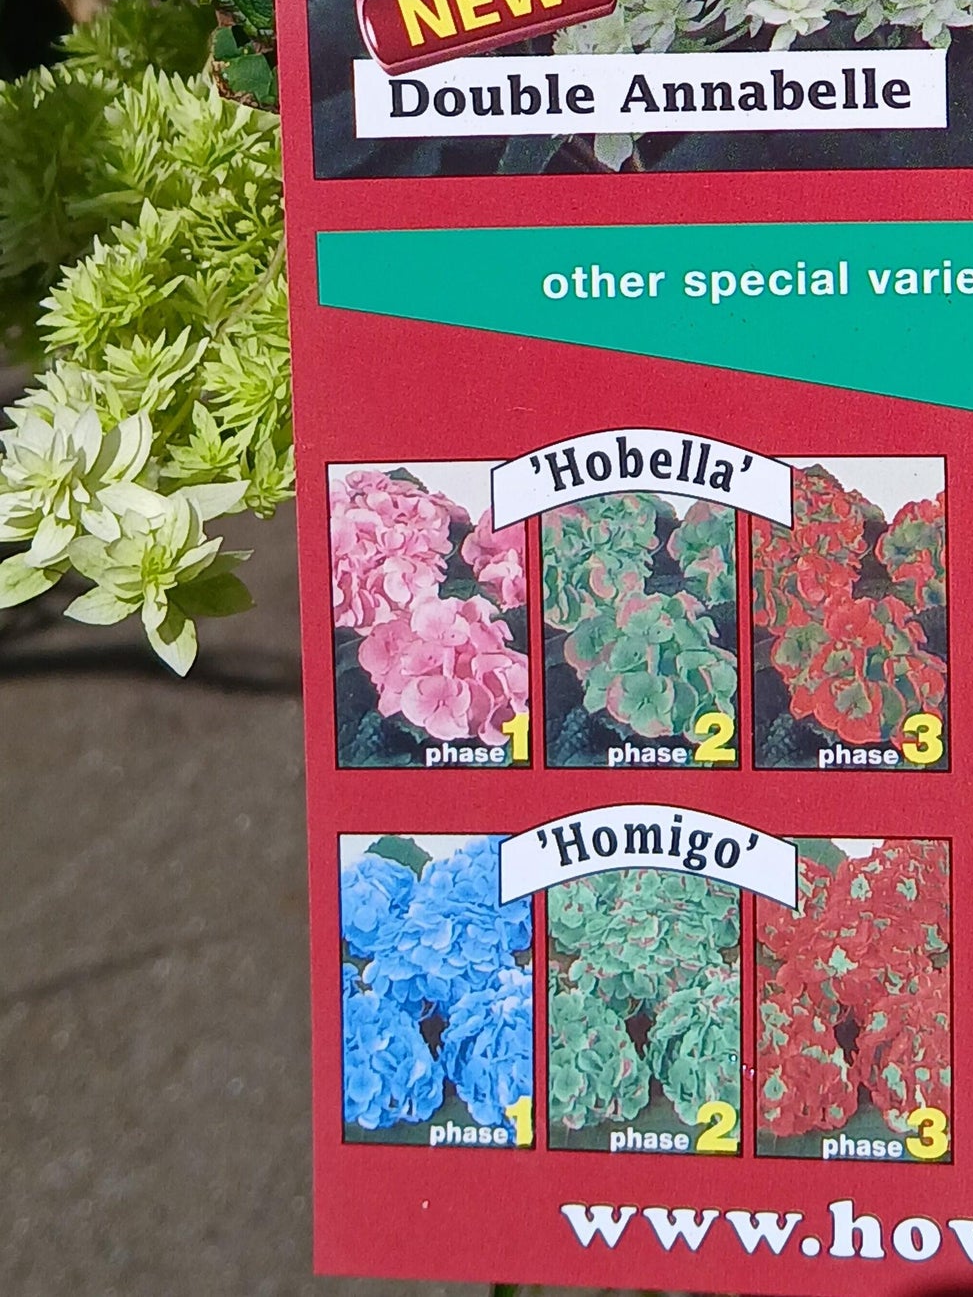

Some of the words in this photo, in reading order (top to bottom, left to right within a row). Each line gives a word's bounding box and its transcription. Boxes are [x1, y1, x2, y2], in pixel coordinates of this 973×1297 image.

[388, 72, 595, 120] Double
[620, 67, 912, 114] Annabelle
[541, 265, 664, 302] other
[682, 261, 850, 304] special
[425, 742, 504, 767] phase
[502, 712, 529, 762] 1
[607, 742, 687, 767] phase
[693, 712, 736, 762] 2
[818, 743, 898, 769] phase
[901, 712, 944, 765] 3
[429, 1122, 509, 1147] phase
[506, 1097, 533, 1147] 1
[609, 1128, 689, 1153] phase
[695, 1101, 738, 1151] 2
[822, 1134, 903, 1159] phase
[905, 1107, 949, 1159] 3
